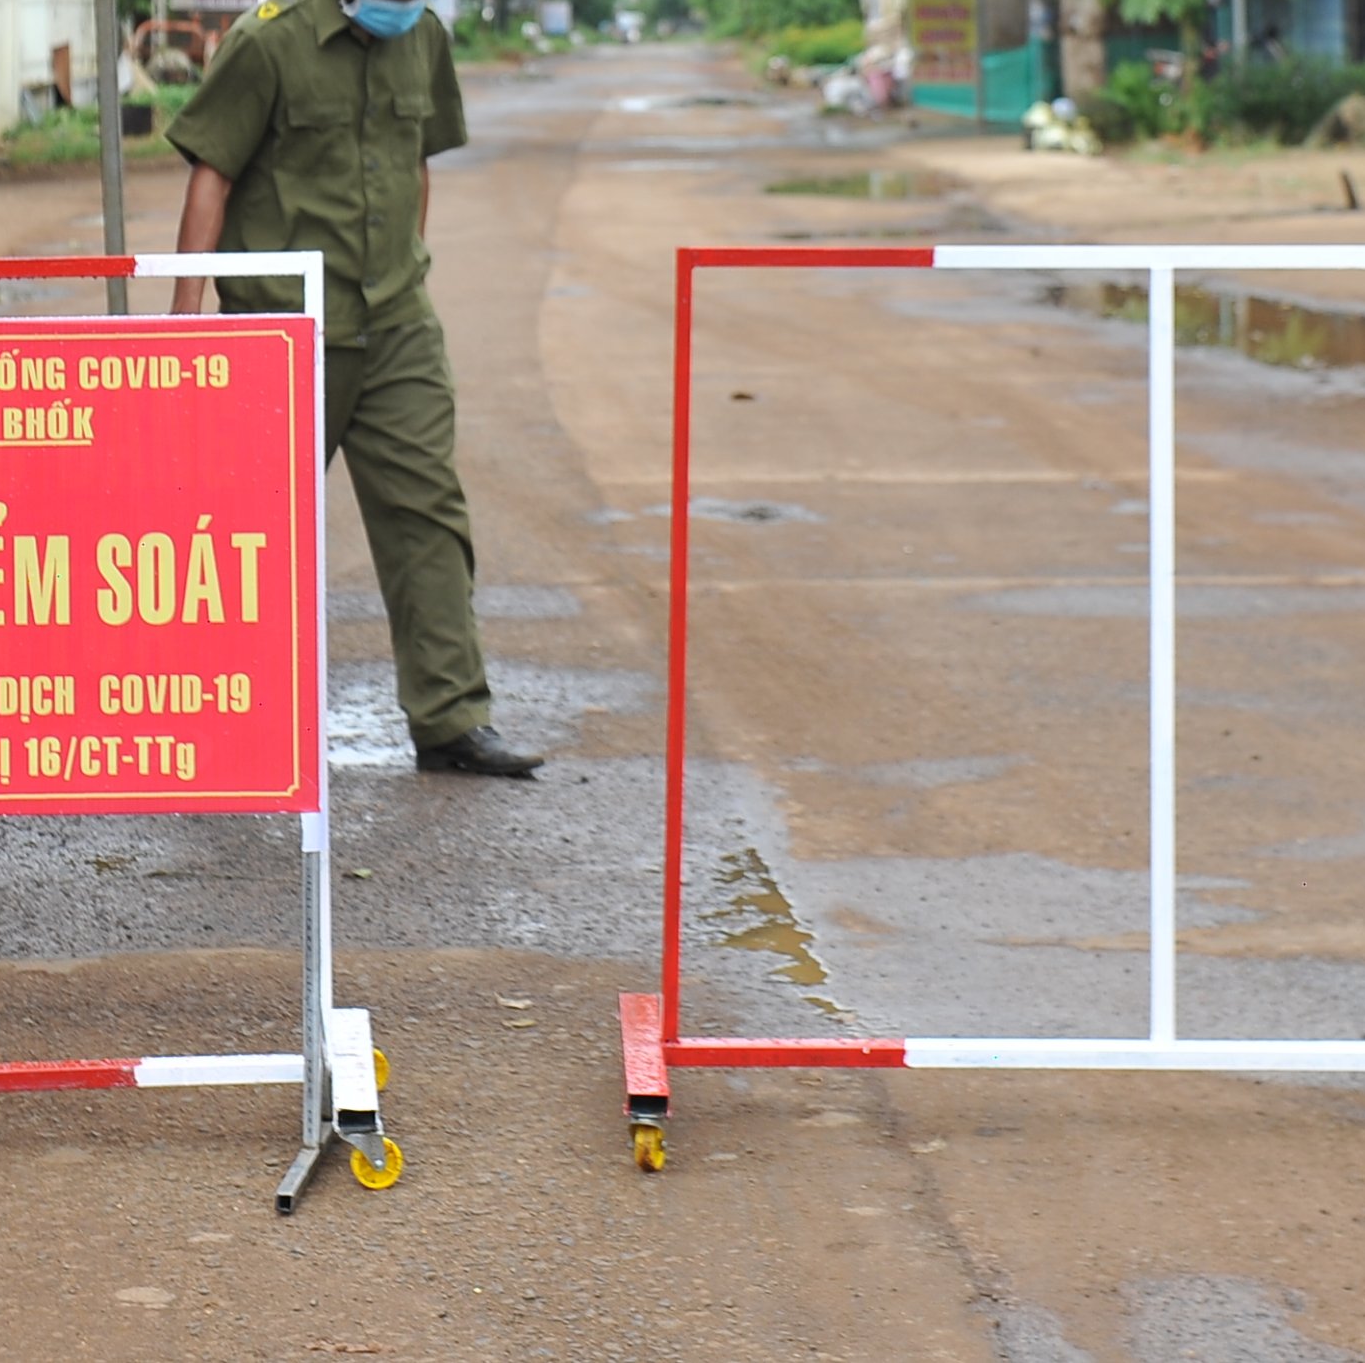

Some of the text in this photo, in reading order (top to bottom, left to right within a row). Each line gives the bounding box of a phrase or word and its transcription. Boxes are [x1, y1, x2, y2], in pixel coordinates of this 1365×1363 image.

[79, 354, 229, 389] COVID-19
[4, 398, 93, 439] BHỐK
[97, 515, 266, 625] SOÁT
[100, 673, 250, 714] COVID-19
[25, 736, 195, 780] 16/CT-TTg
